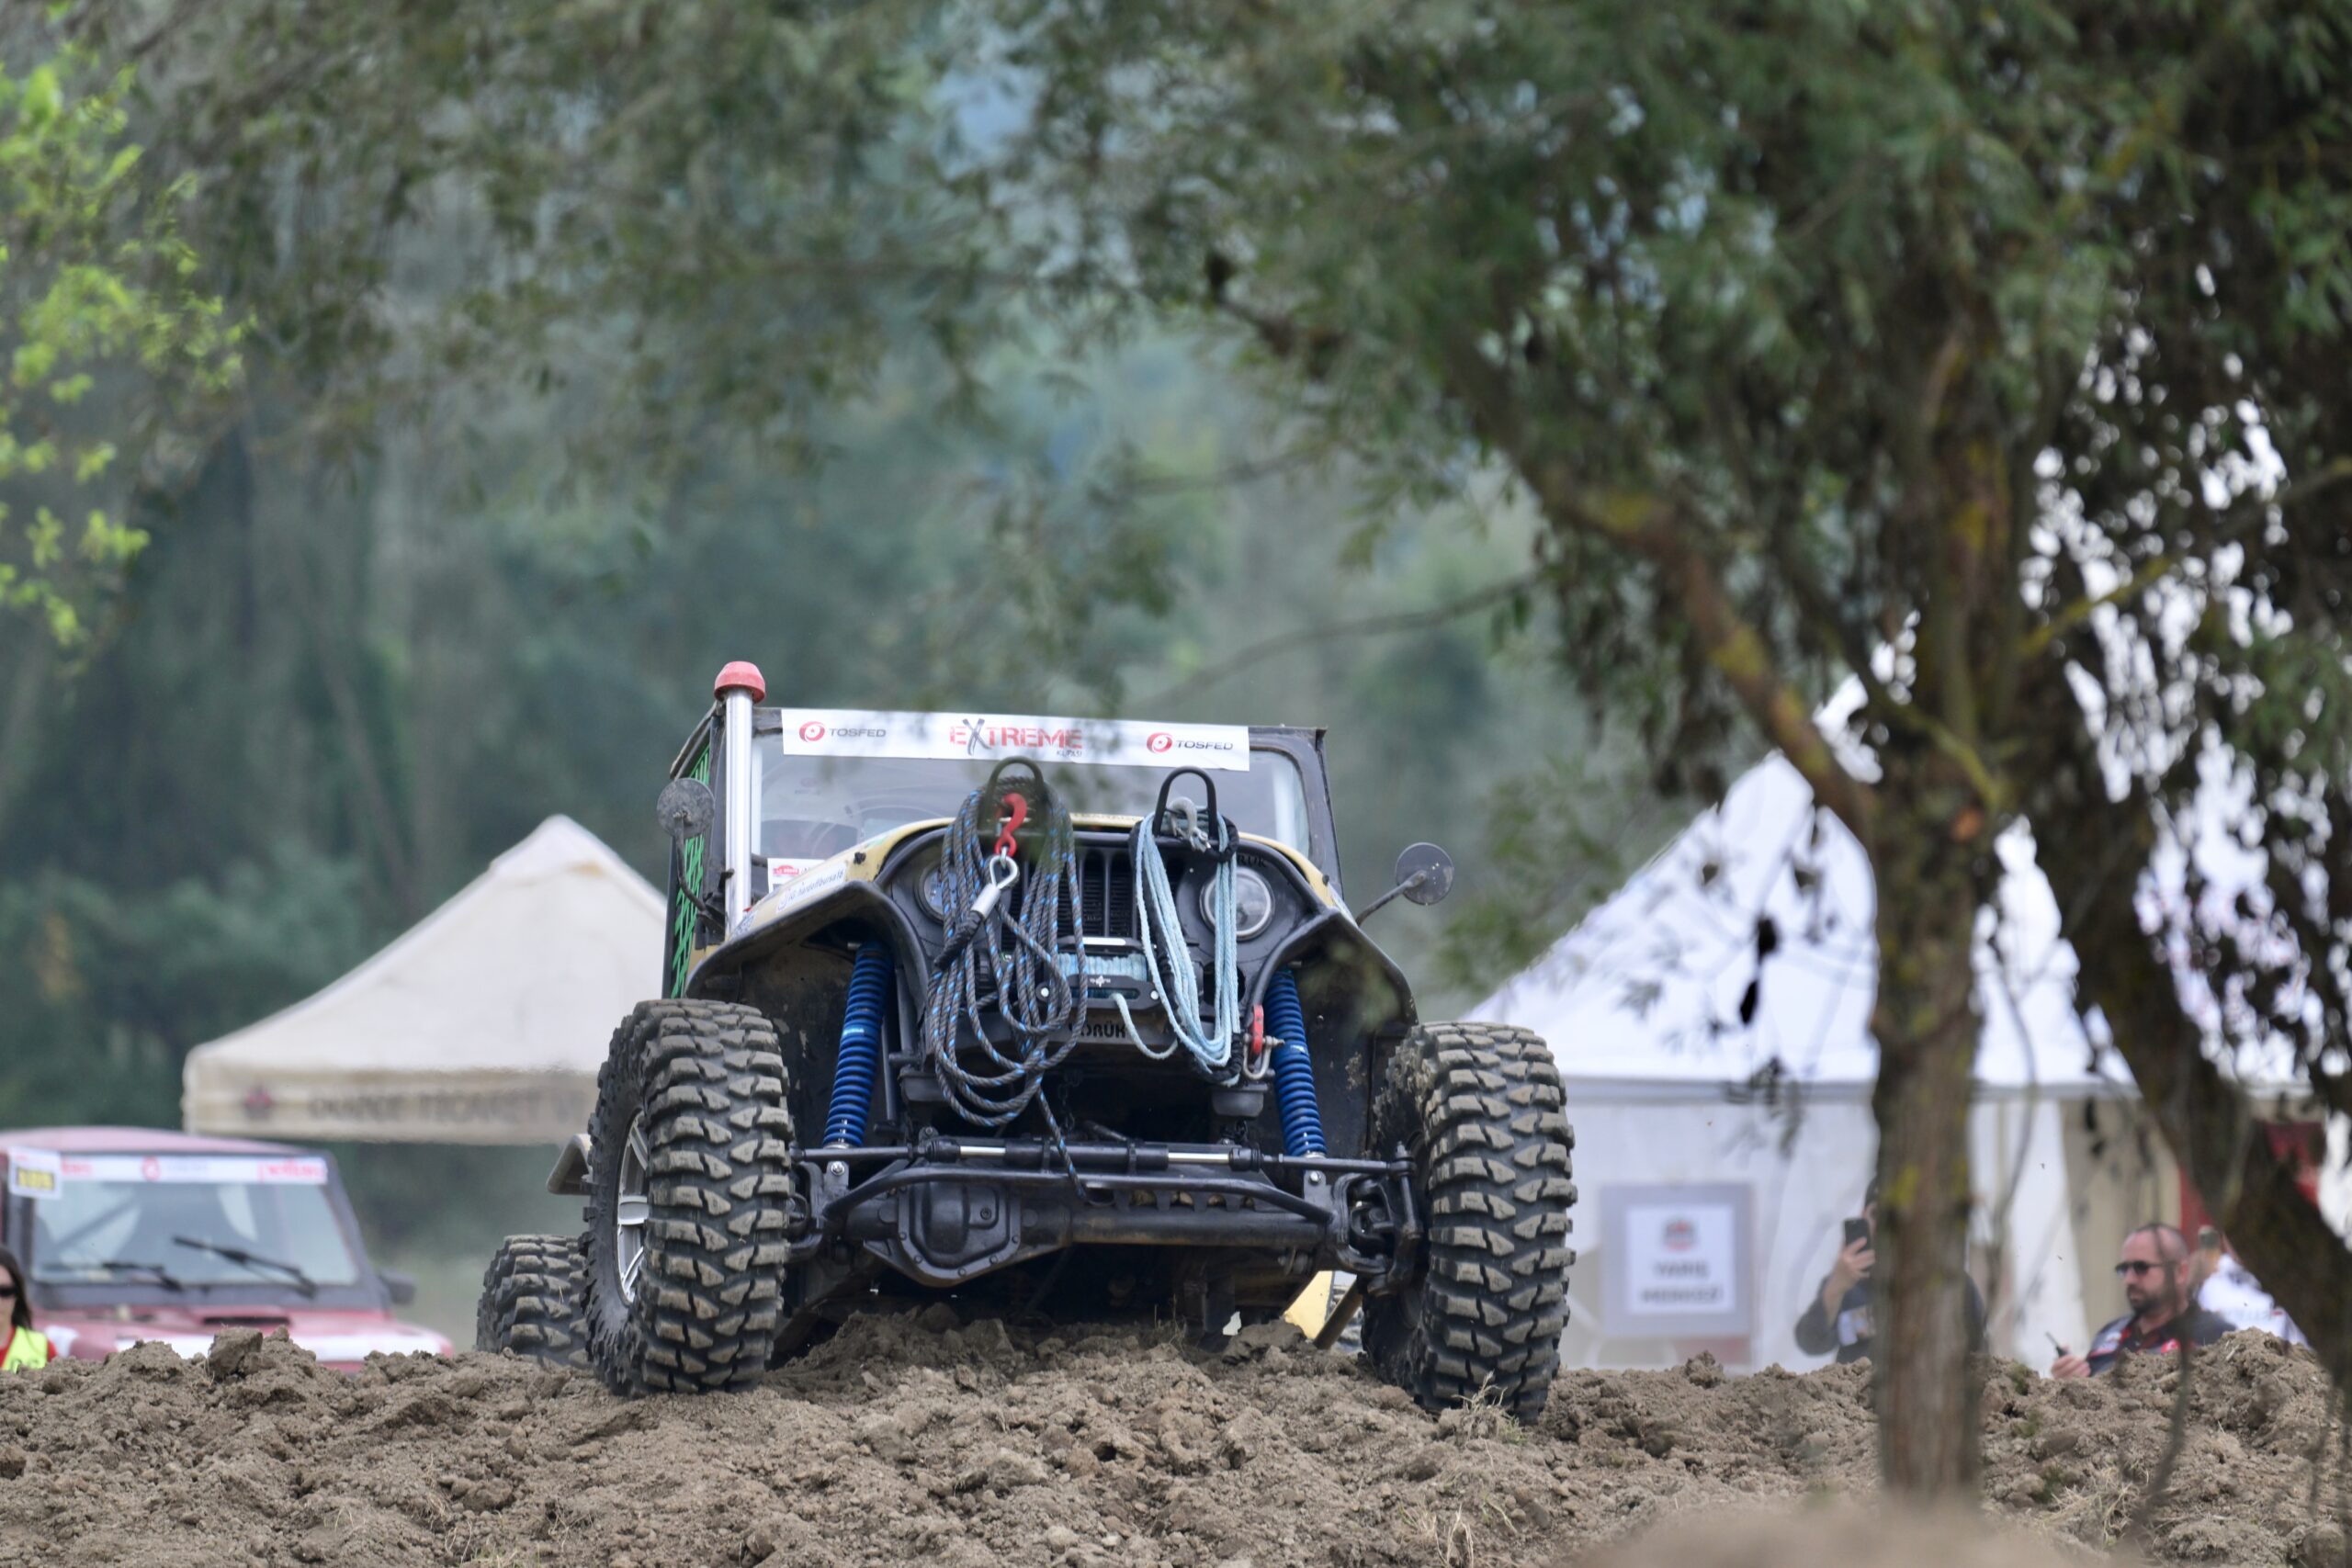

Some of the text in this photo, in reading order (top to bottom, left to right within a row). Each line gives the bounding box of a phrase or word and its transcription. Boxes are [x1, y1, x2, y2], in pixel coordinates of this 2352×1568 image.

[829, 728, 887, 738] TOSFED
[949, 718, 1082, 756] EXTREME
[1177, 739, 1233, 750] TOSFED
